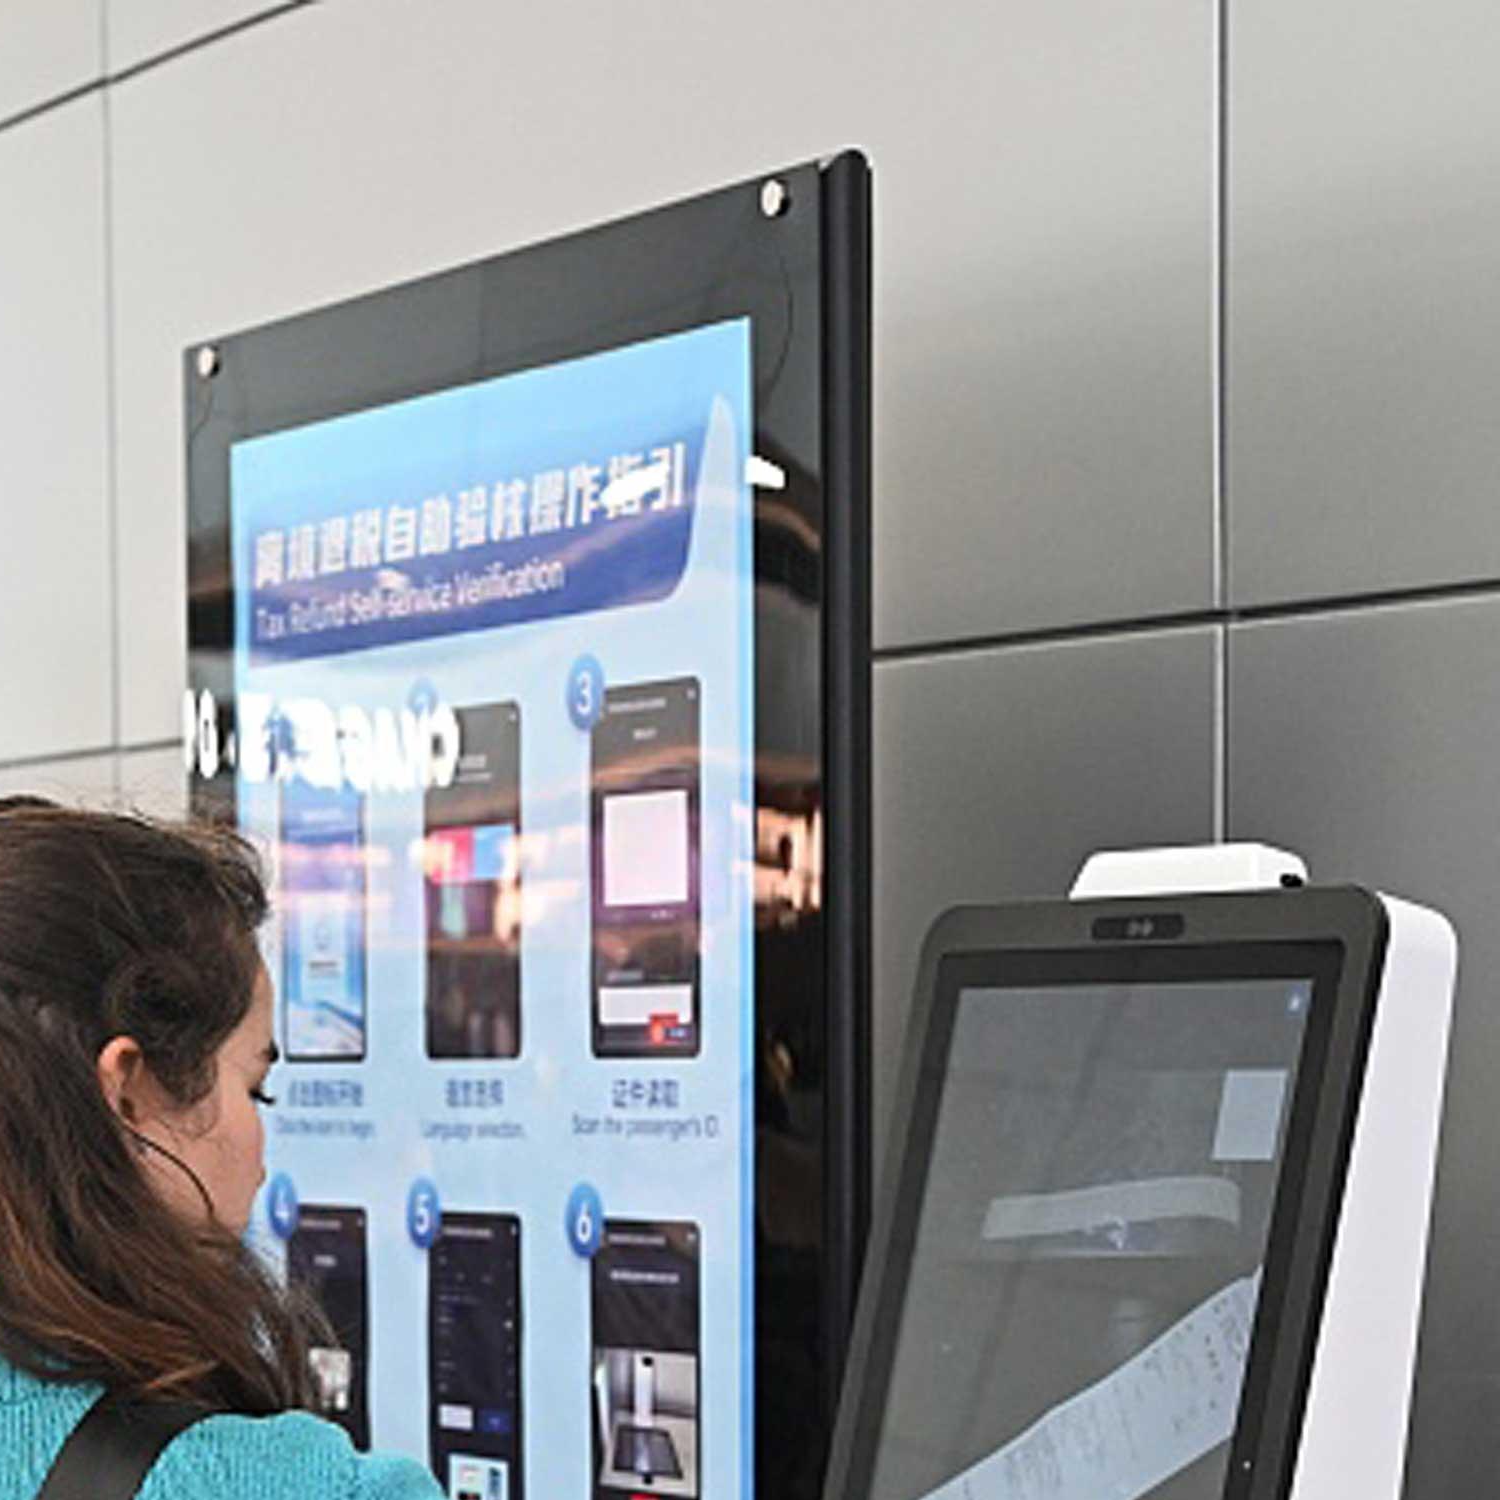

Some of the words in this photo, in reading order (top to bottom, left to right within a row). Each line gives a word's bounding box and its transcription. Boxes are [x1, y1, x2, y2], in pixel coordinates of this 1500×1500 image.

[455, 559, 565, 606] Verification
[574, 670, 594, 714] 3
[415, 1193, 431, 1234] 5
[575, 1203, 593, 1244] 6
